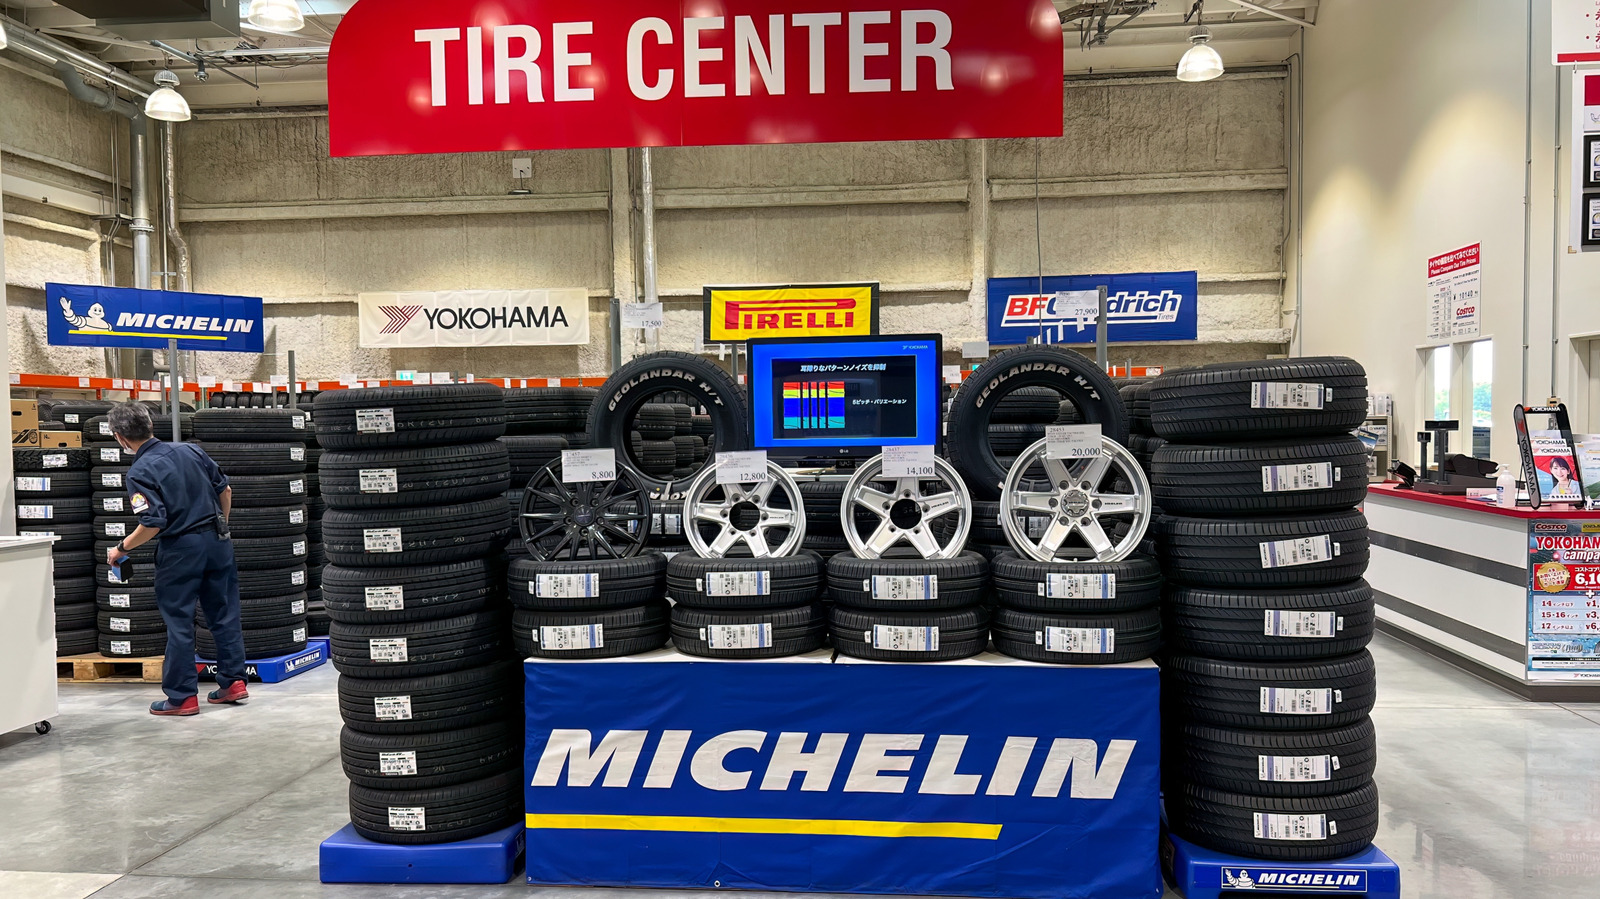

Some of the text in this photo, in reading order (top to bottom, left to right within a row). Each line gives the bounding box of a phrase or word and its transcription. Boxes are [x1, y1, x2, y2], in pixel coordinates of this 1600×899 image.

[414, 9, 955, 107] TIRE CENTER
[423, 305, 569, 330] YOKOHAMA
[724, 297, 857, 331] PIRELLI
[1075, 308, 1098, 316] 27,900
[1157, 313, 1174, 321] Tires
[116, 312, 254, 333] MICHELIN
[641, 320, 662, 328] 17,500
[608, 368, 724, 412] GEOLANDAR H/T
[975, 362, 1101, 409] GEOLANDAR H/T
[1071, 447, 1101, 457] 20,000
[906, 466, 933, 475] 14,100
[1521, 436, 1537, 495] YOKOHAMA
[591, 470, 614, 479] 8,800
[740, 472, 766, 481] 12,800
[294, 651, 321, 666] MICHELIN
[530, 728, 1137, 799] MICHELIN
[1258, 873, 1360, 886] MICHELIN
